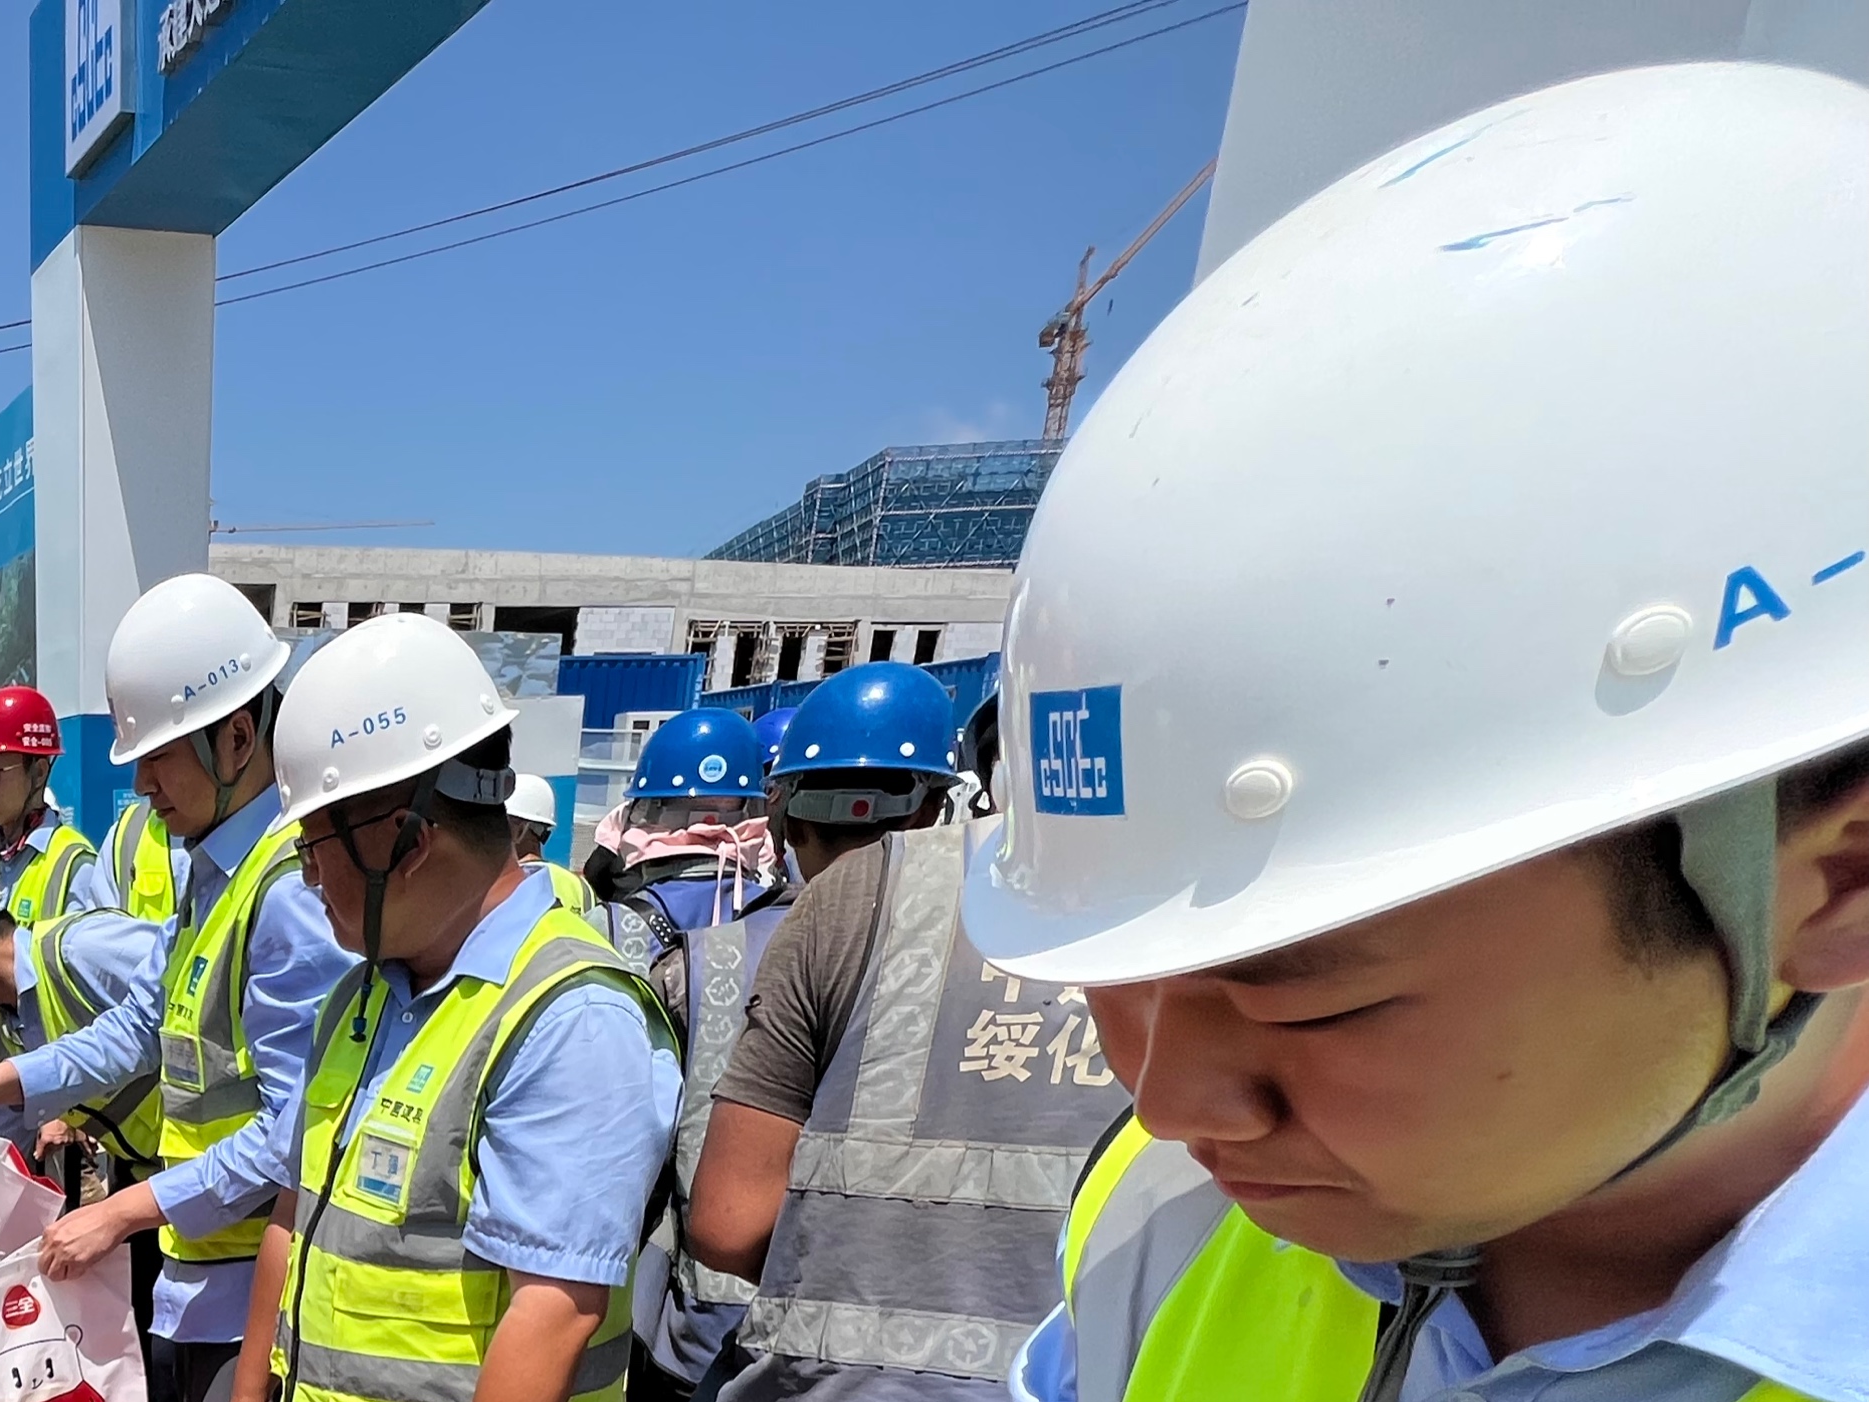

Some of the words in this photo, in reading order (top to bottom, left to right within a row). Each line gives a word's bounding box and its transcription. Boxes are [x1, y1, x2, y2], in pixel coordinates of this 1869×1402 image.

[184, 658, 239, 701] A-013
[330, 706, 407, 749] A-055
[959, 1009, 1115, 1086] 绥化
[5, 1296, 35, 1319] 三全
